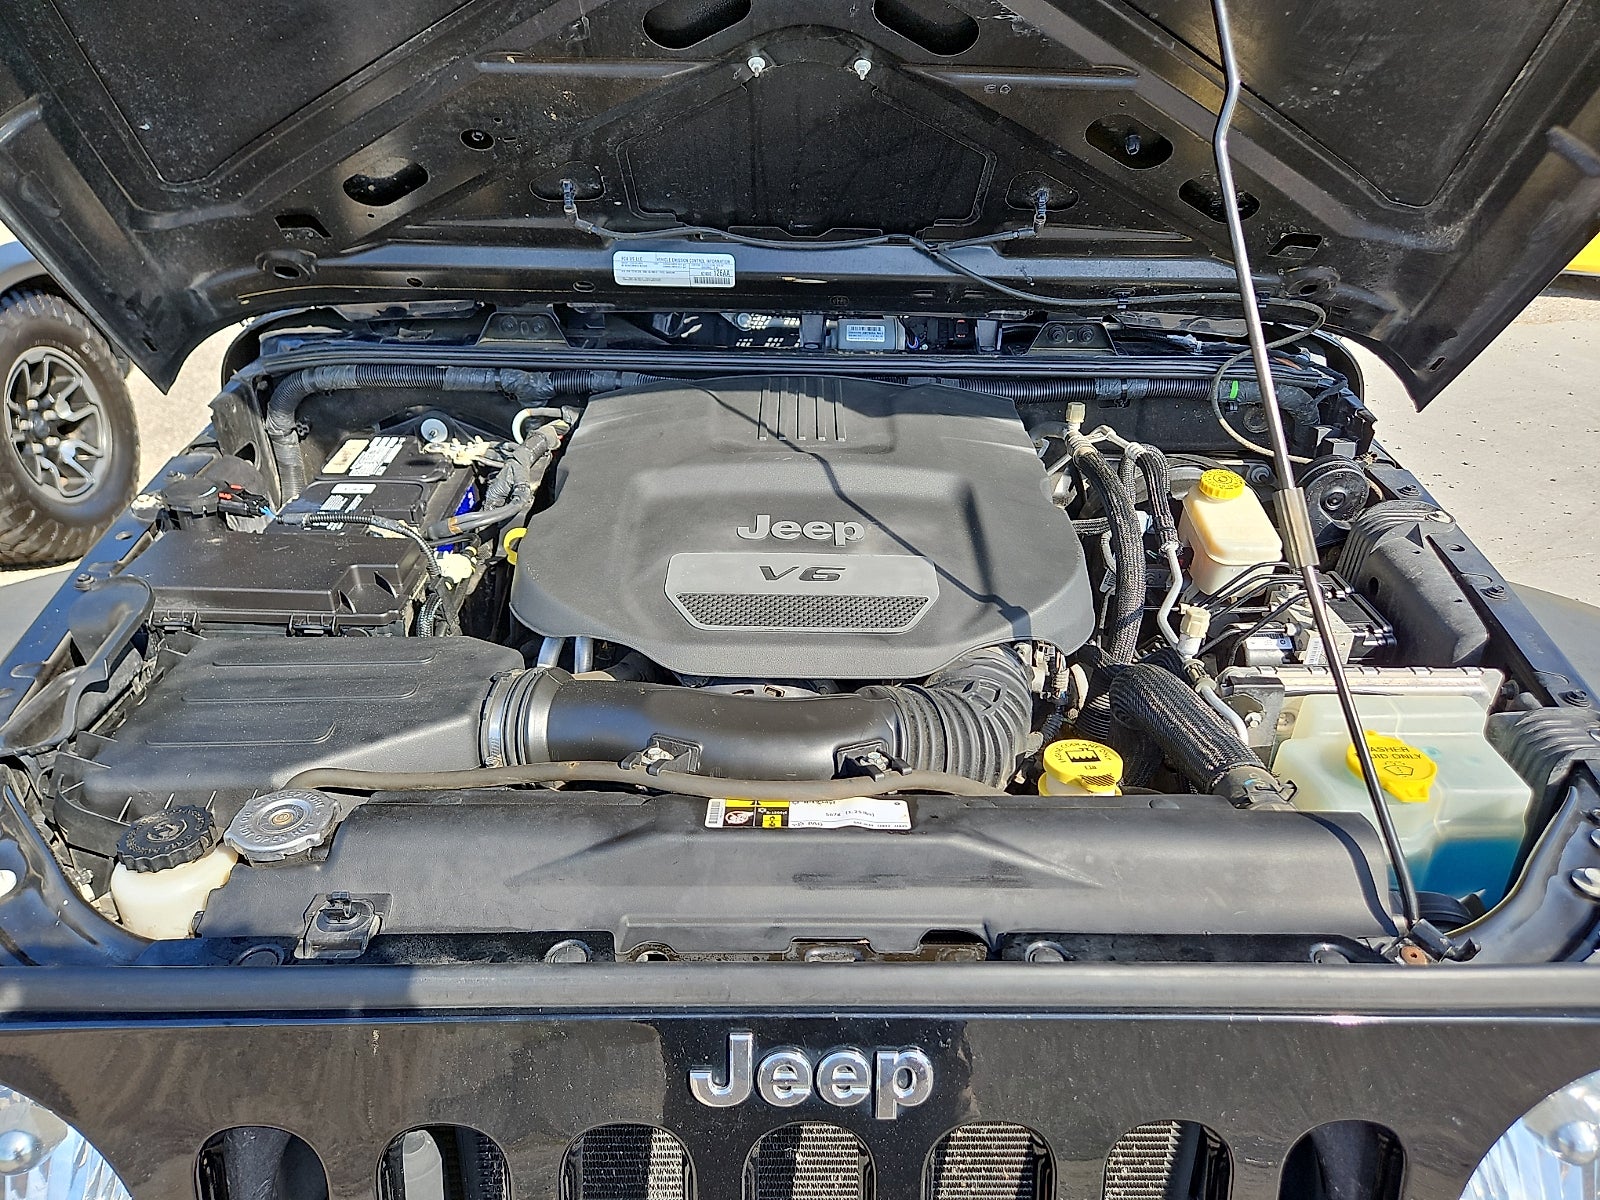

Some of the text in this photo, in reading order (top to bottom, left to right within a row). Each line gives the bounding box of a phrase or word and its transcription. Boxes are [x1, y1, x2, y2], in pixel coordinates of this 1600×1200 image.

[736, 513, 865, 547] Jeep
[758, 565, 846, 582] V6
[690, 1032, 934, 1120] Jeep
